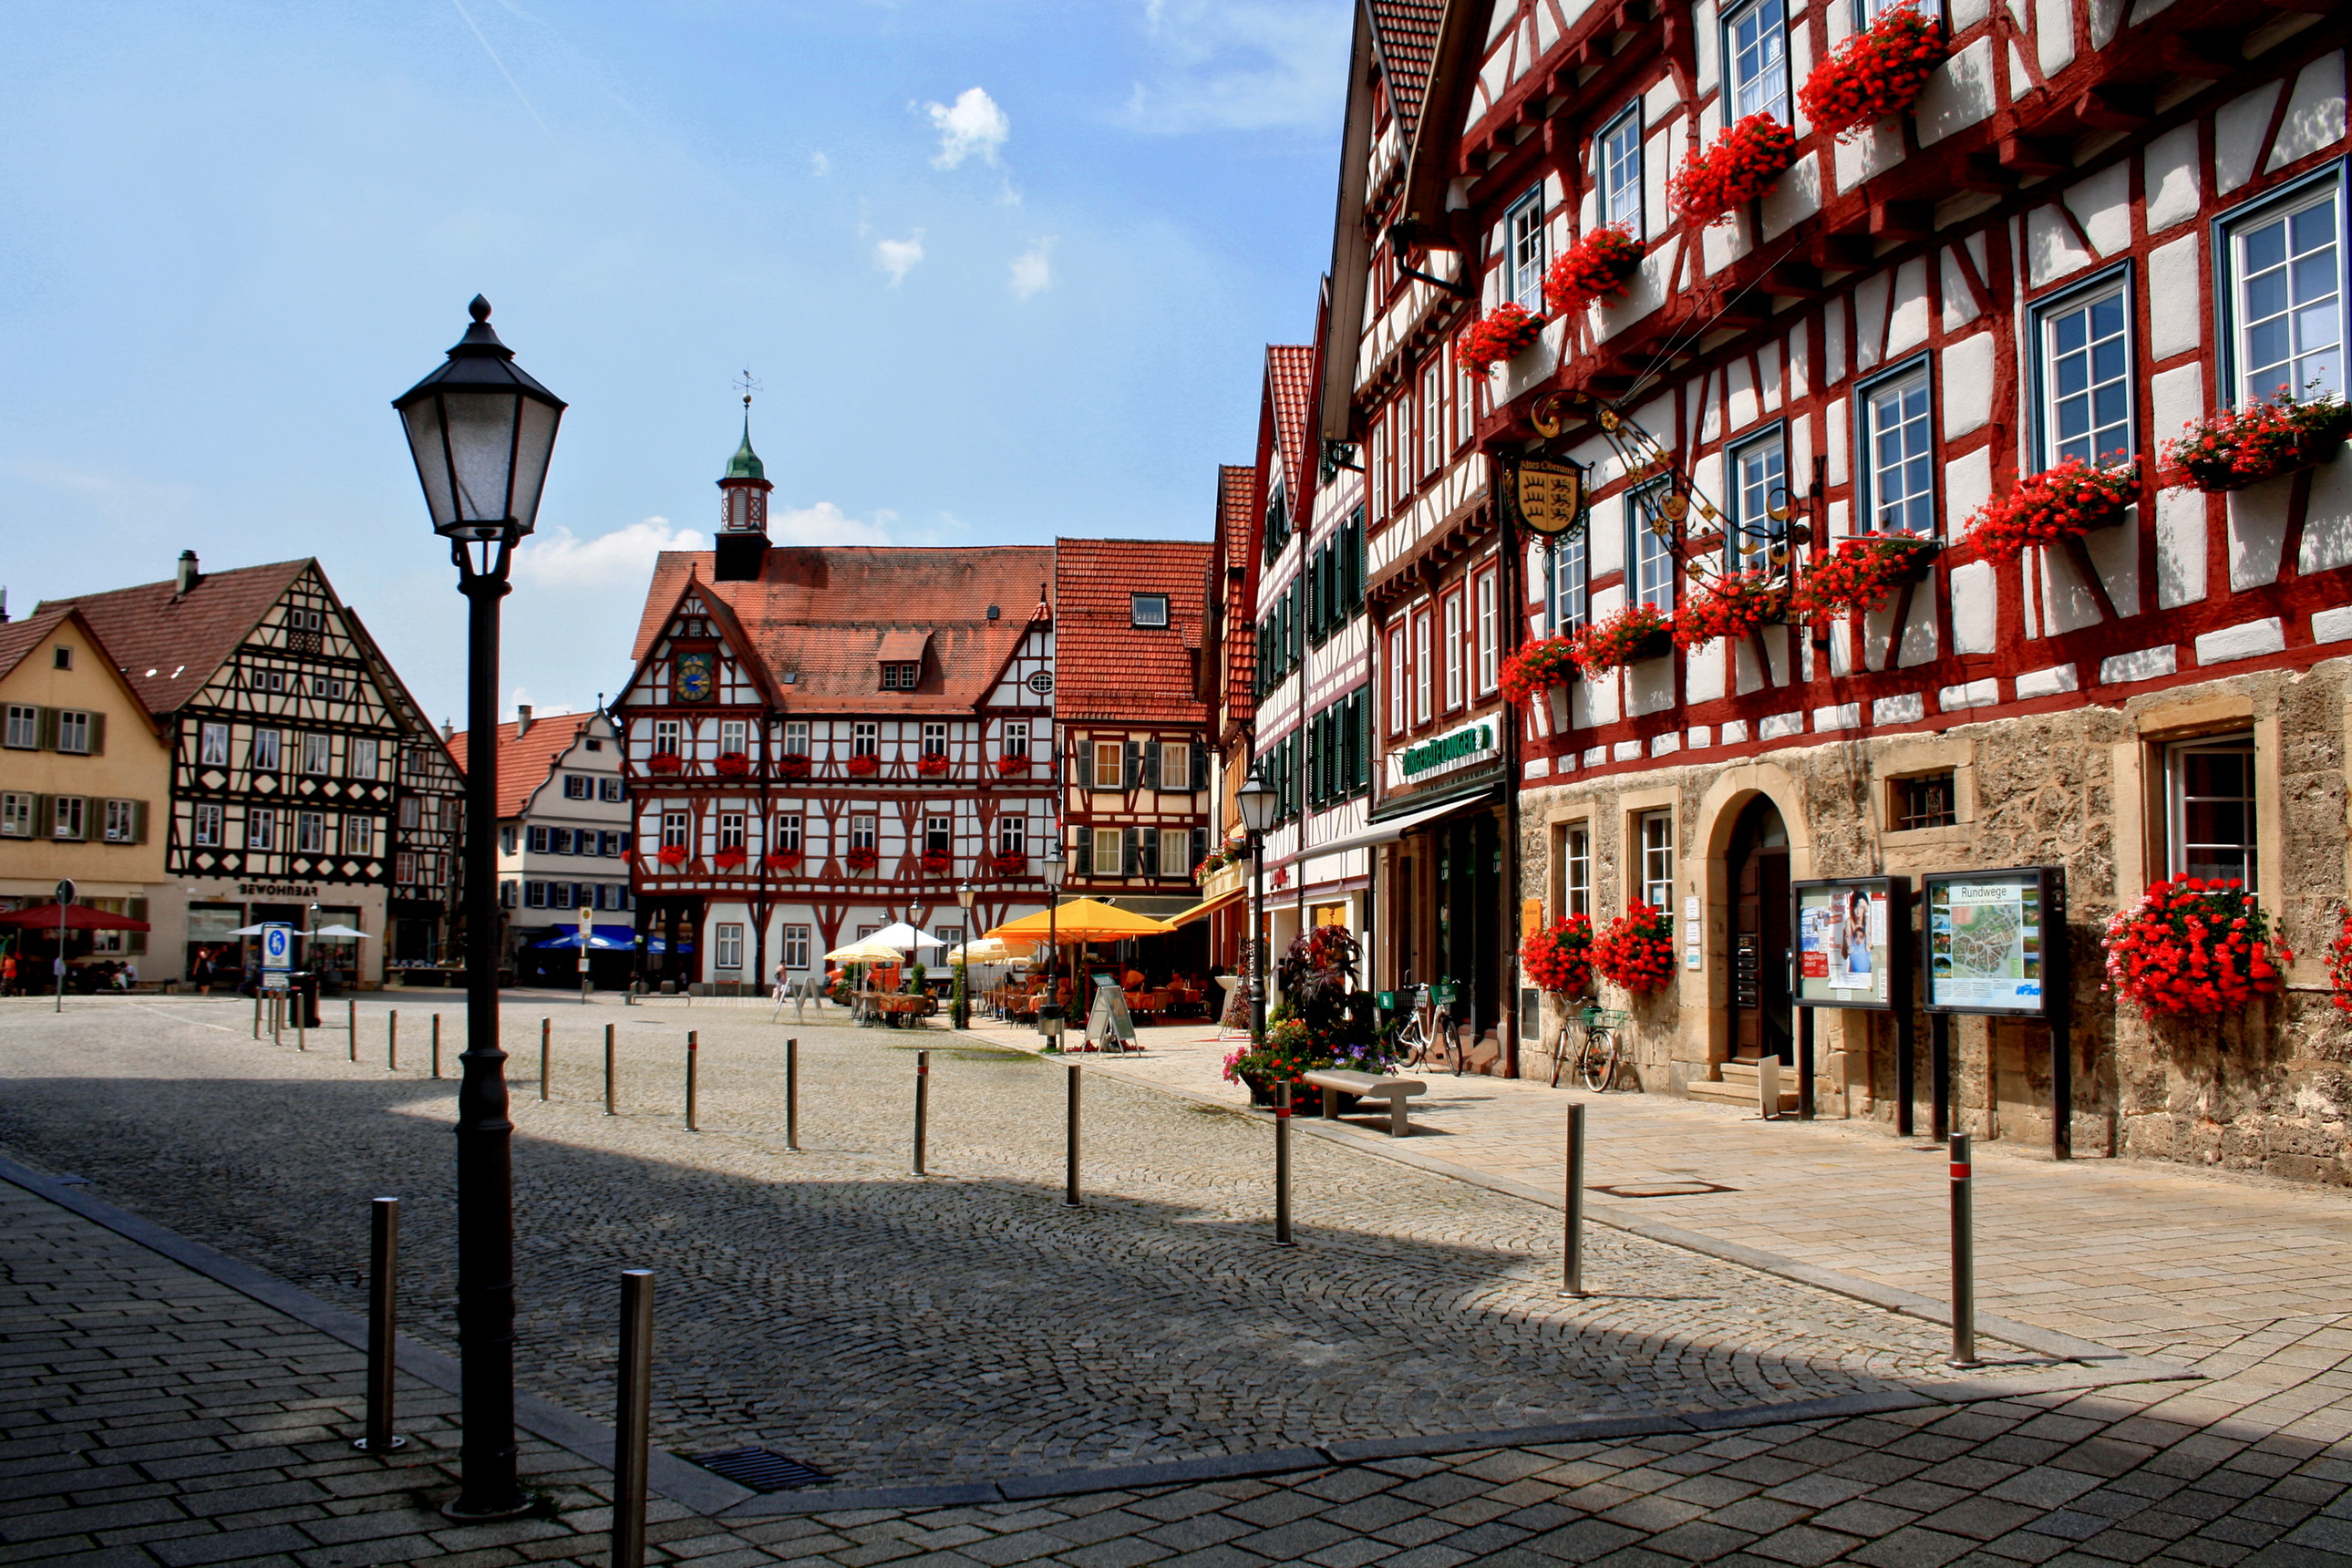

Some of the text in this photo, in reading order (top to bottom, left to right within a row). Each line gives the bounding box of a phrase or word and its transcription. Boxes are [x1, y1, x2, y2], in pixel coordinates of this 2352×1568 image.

[1519, 459, 1578, 476] Altes Oberamt
[1441, 727, 1476, 763] LANGER
[1961, 886, 2006, 899] Rundwege
